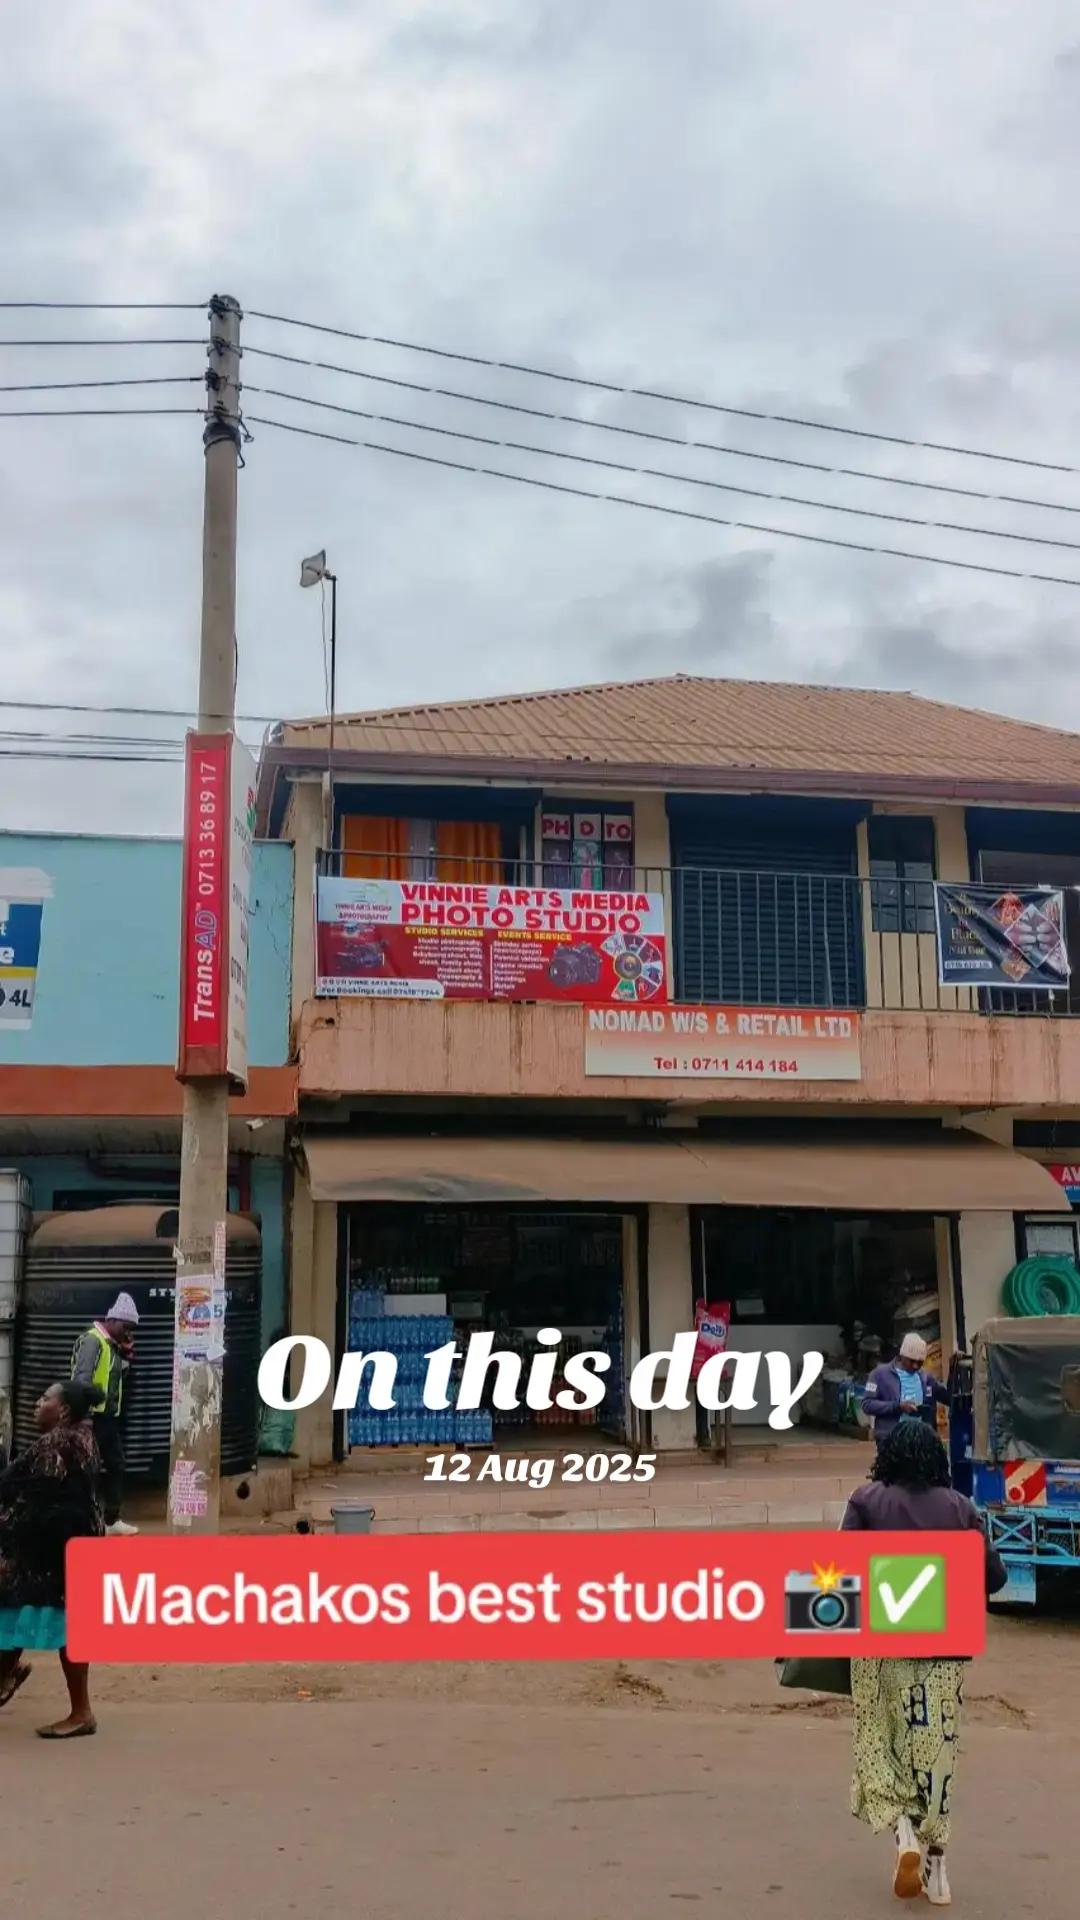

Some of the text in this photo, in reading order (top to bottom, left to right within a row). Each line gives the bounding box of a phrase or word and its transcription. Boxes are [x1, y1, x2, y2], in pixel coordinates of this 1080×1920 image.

[200, 762, 216, 783] 17
[200, 790, 216, 814] 89
[199, 819, 216, 842] 36
[198, 848, 215, 896] 0713
[401, 884, 650, 912] VINNIE ARTS MEDIA
[402, 903, 641, 933] PHOTO STUDIO
[405, 926, 484, 938] STUDIO SERVICES
[497, 930, 572, 941] EVENTS SERVICE
[8, 988, 32, 1008] 4L
[588, 1009, 851, 1038] NOMAD W/S & RETAIL LTD
[653, 1057, 677, 1070] Tel
[692, 1058, 729, 1072] 0711
[736, 1058, 764, 1072] 414
[771, 1059, 798, 1073] 184
